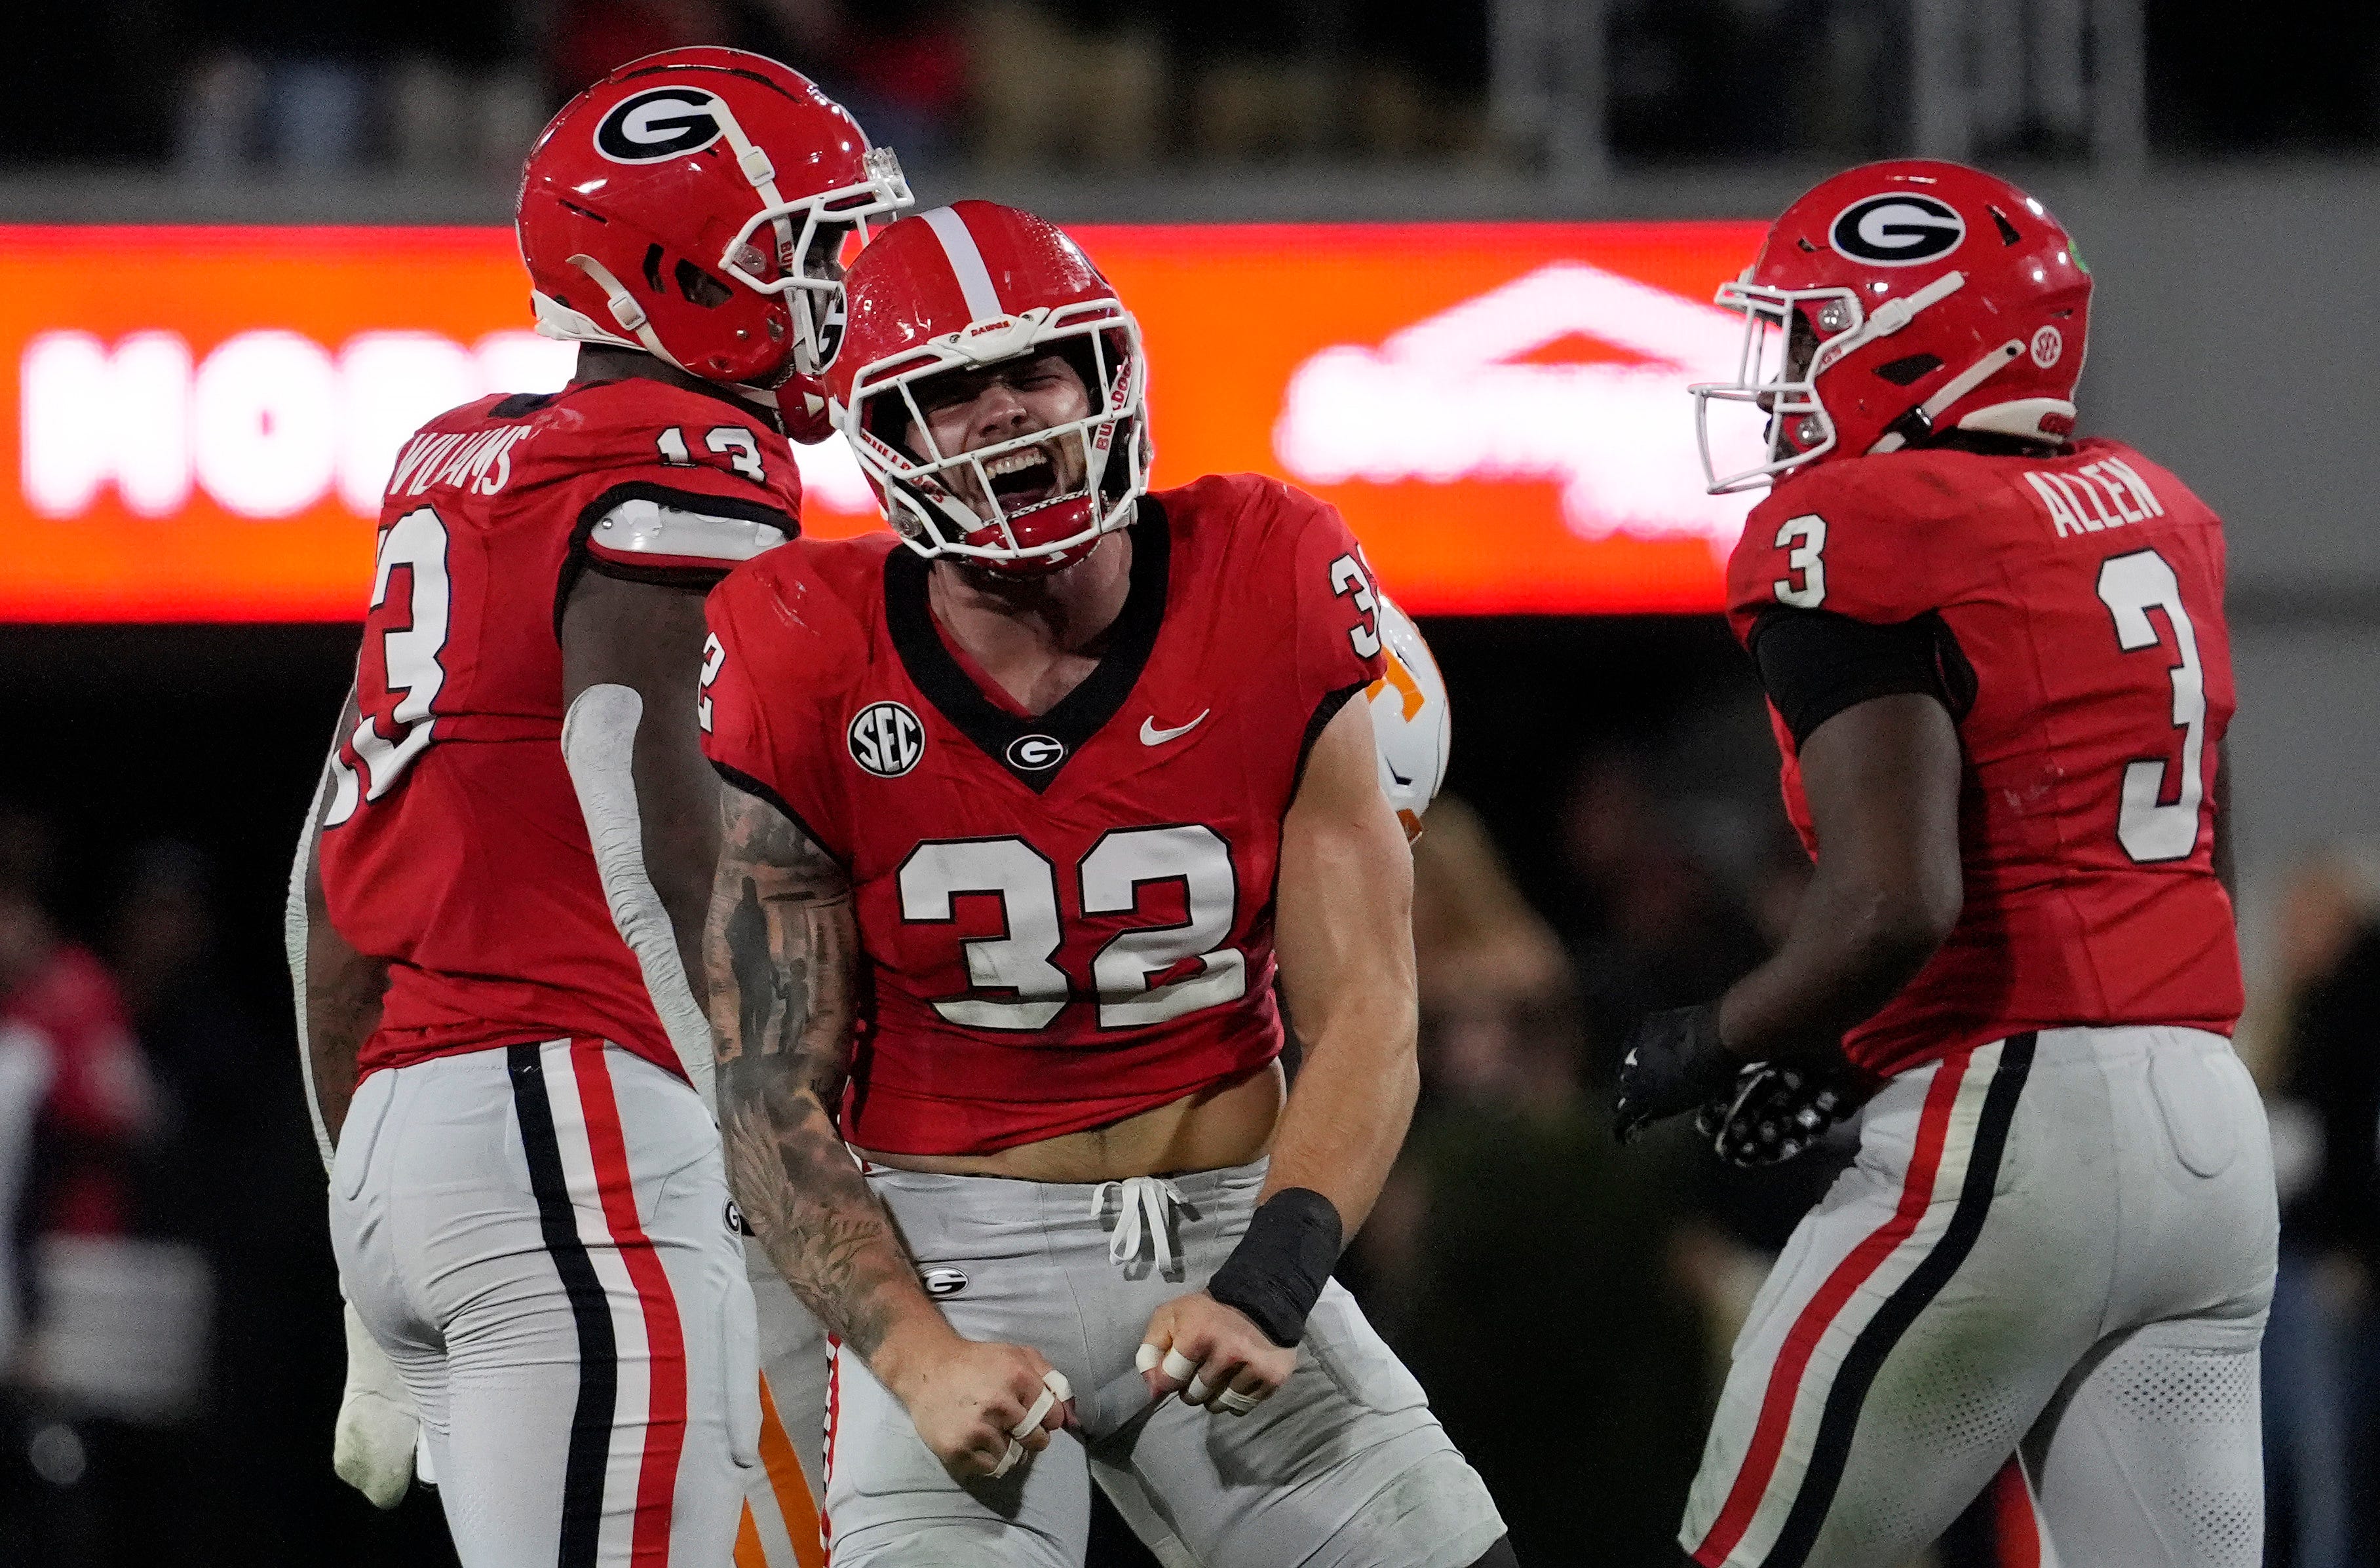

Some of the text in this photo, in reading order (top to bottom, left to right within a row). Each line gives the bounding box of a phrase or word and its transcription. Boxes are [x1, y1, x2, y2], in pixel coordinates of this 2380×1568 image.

[595, 86, 723, 163] G
[1832, 194, 1963, 263] G
[657, 427, 765, 483] 13
[2024, 457, 2164, 538] ALLEN
[1330, 544, 1381, 658] 3
[1773, 514, 1827, 609] 3
[853, 706, 919, 773] SEC
[2098, 549, 2207, 862] 3
[1007, 735, 1064, 770] G
[898, 824, 1246, 1030] 32
